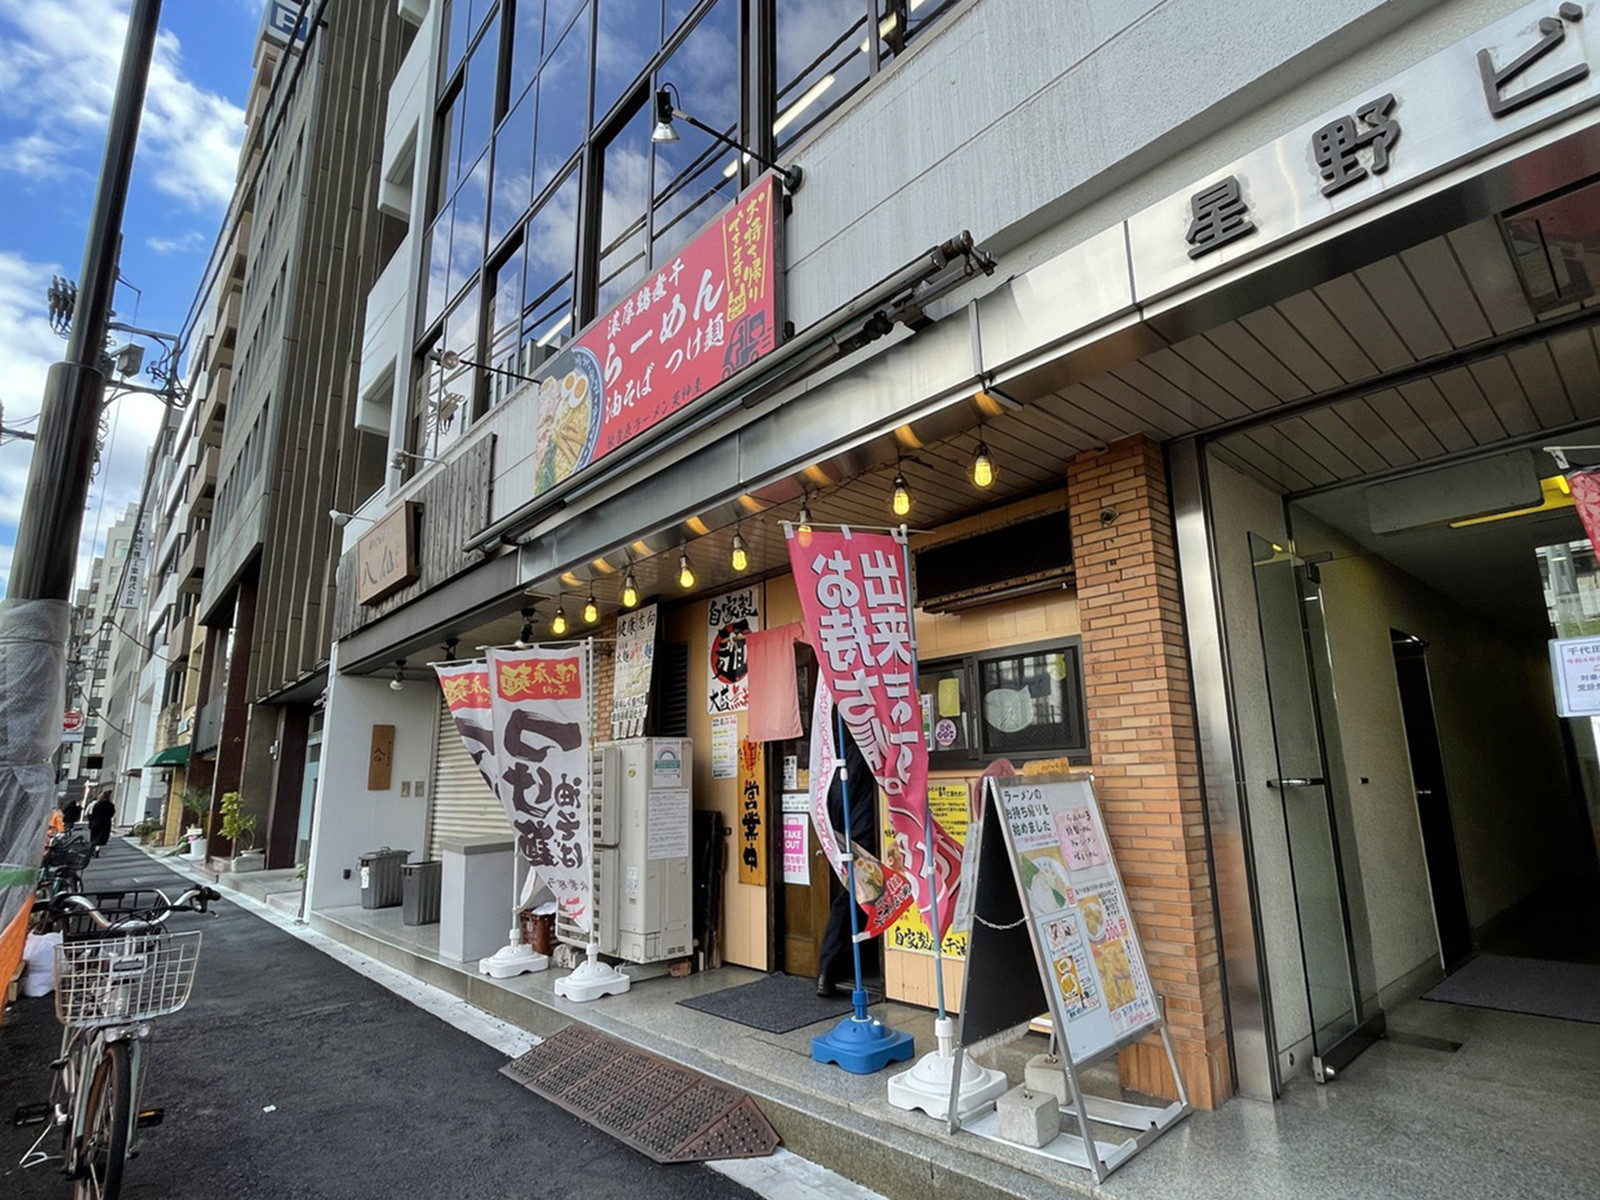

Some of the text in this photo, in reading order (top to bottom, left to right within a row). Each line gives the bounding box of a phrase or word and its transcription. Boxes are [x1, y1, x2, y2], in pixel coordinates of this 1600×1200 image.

[1185, 2, 1590, 260] 星野ビ
[604, 268, 725, 389] らーめん
[665, 311, 725, 374] つけ麺
[605, 361, 656, 424] 油そば
[709, 590, 758, 626] 自家製
[1004, 789, 1042, 803] ラーメンの
[1006, 804, 1050, 820] お持ち帰りを
[742, 780, 761, 873] 営業中
[784, 829, 802, 839] TAKE
[784, 840, 801, 849] OUT
[1012, 820, 1051, 836] 始めました
